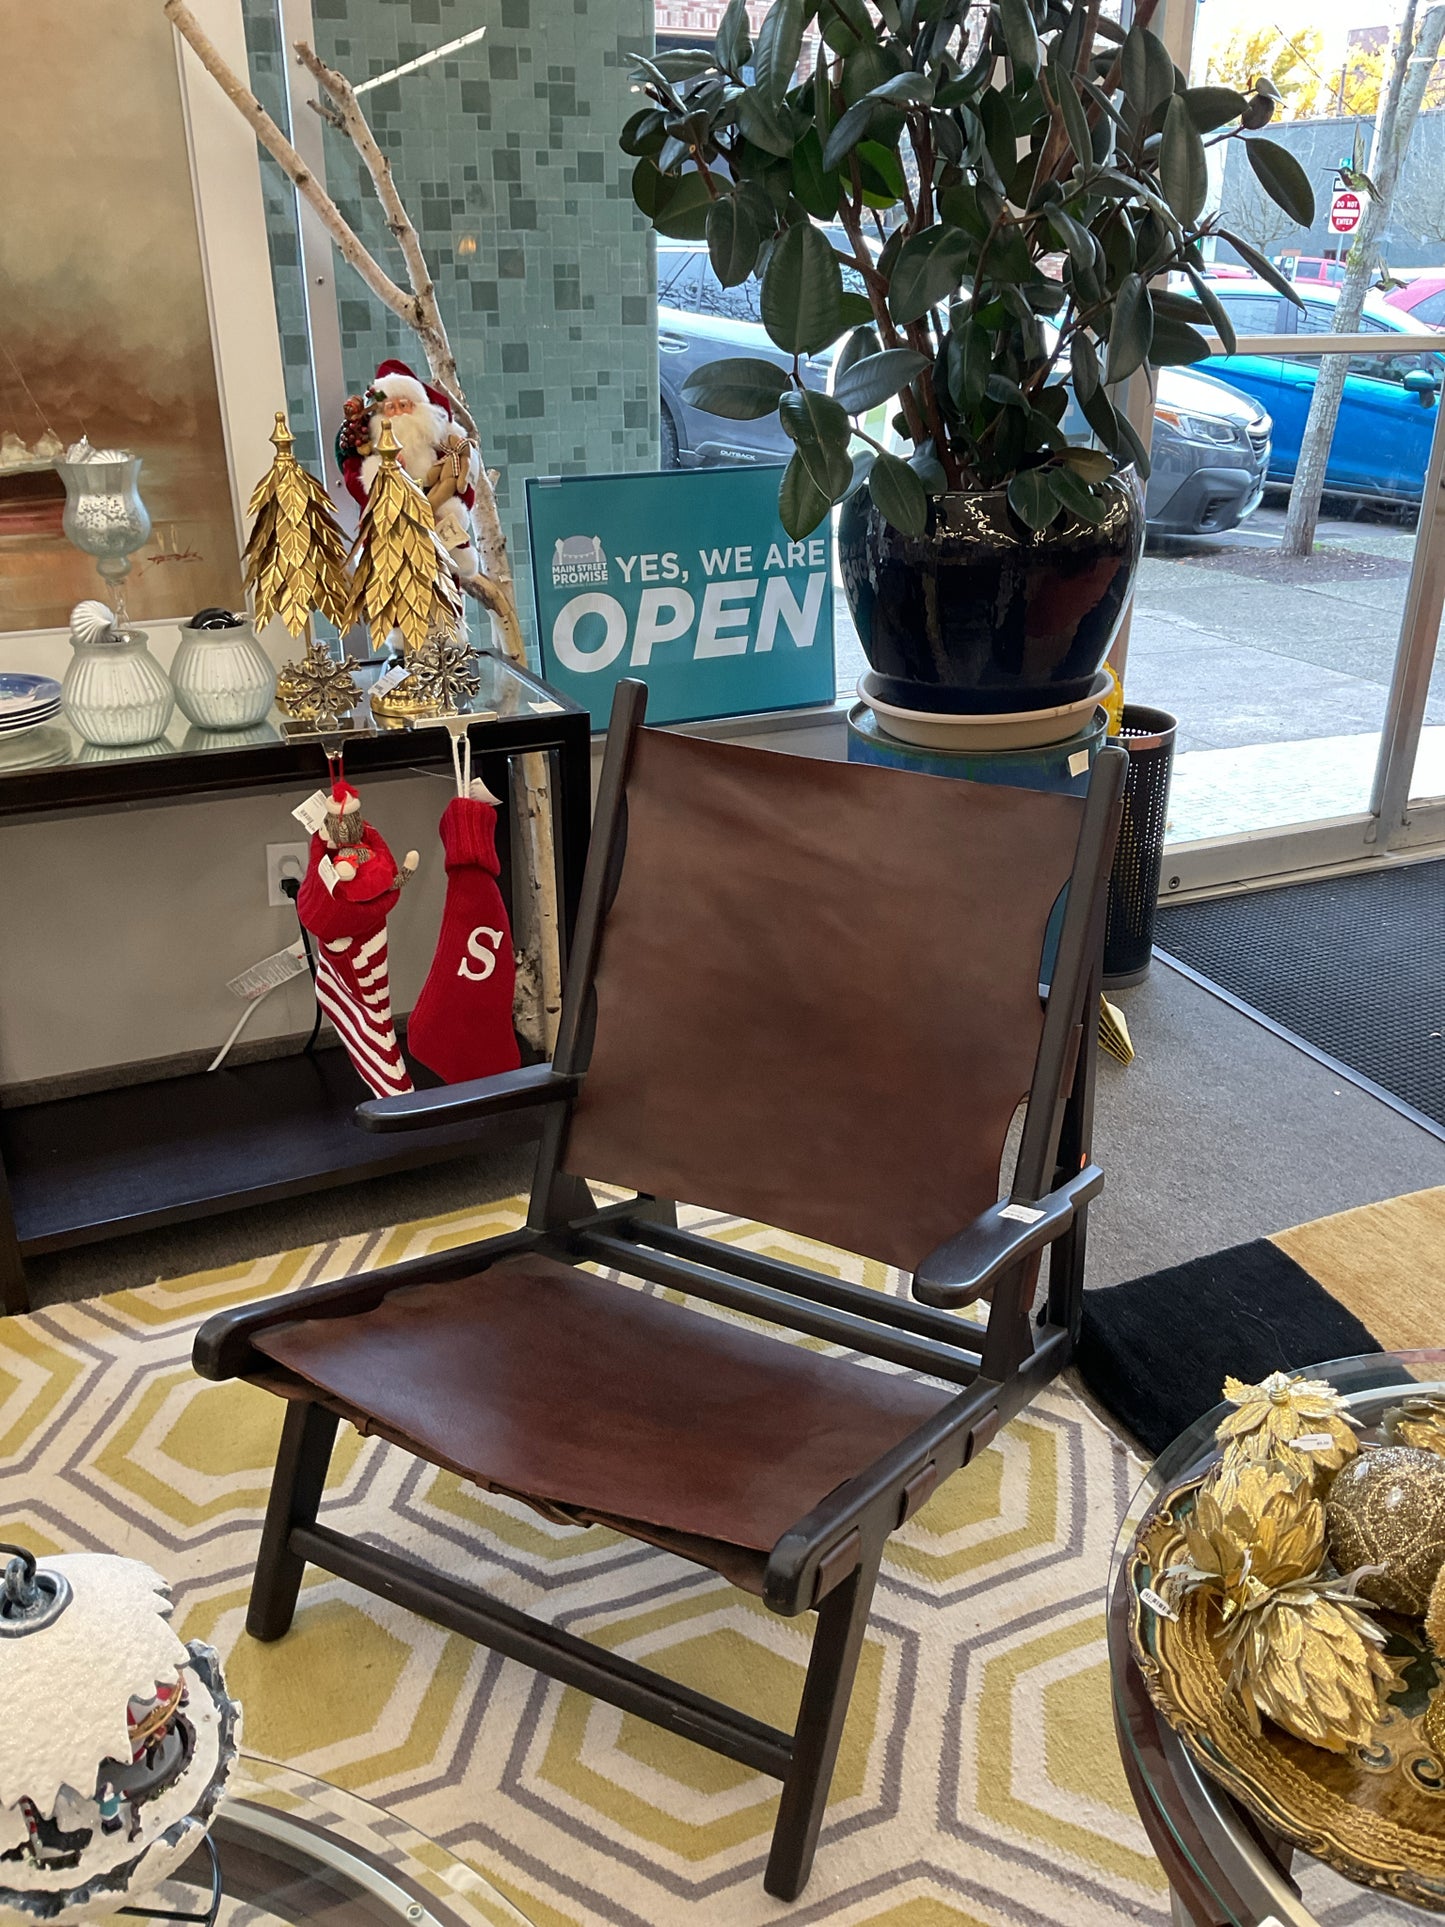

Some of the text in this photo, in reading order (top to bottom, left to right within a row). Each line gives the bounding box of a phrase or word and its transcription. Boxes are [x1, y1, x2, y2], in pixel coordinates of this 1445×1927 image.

[1336, 200, 1358, 208] DO NOT
[1336, 218, 1353, 226] ENTER
[720, 449, 756, 461] OUTBACK
[615, 539, 826, 583] YES, WE ARE
[552, 562, 607, 574] MAIN STREET
[553, 570, 609, 585] PROMISE
[552, 572, 827, 673] OPEN
[457, 926, 504, 981] S
